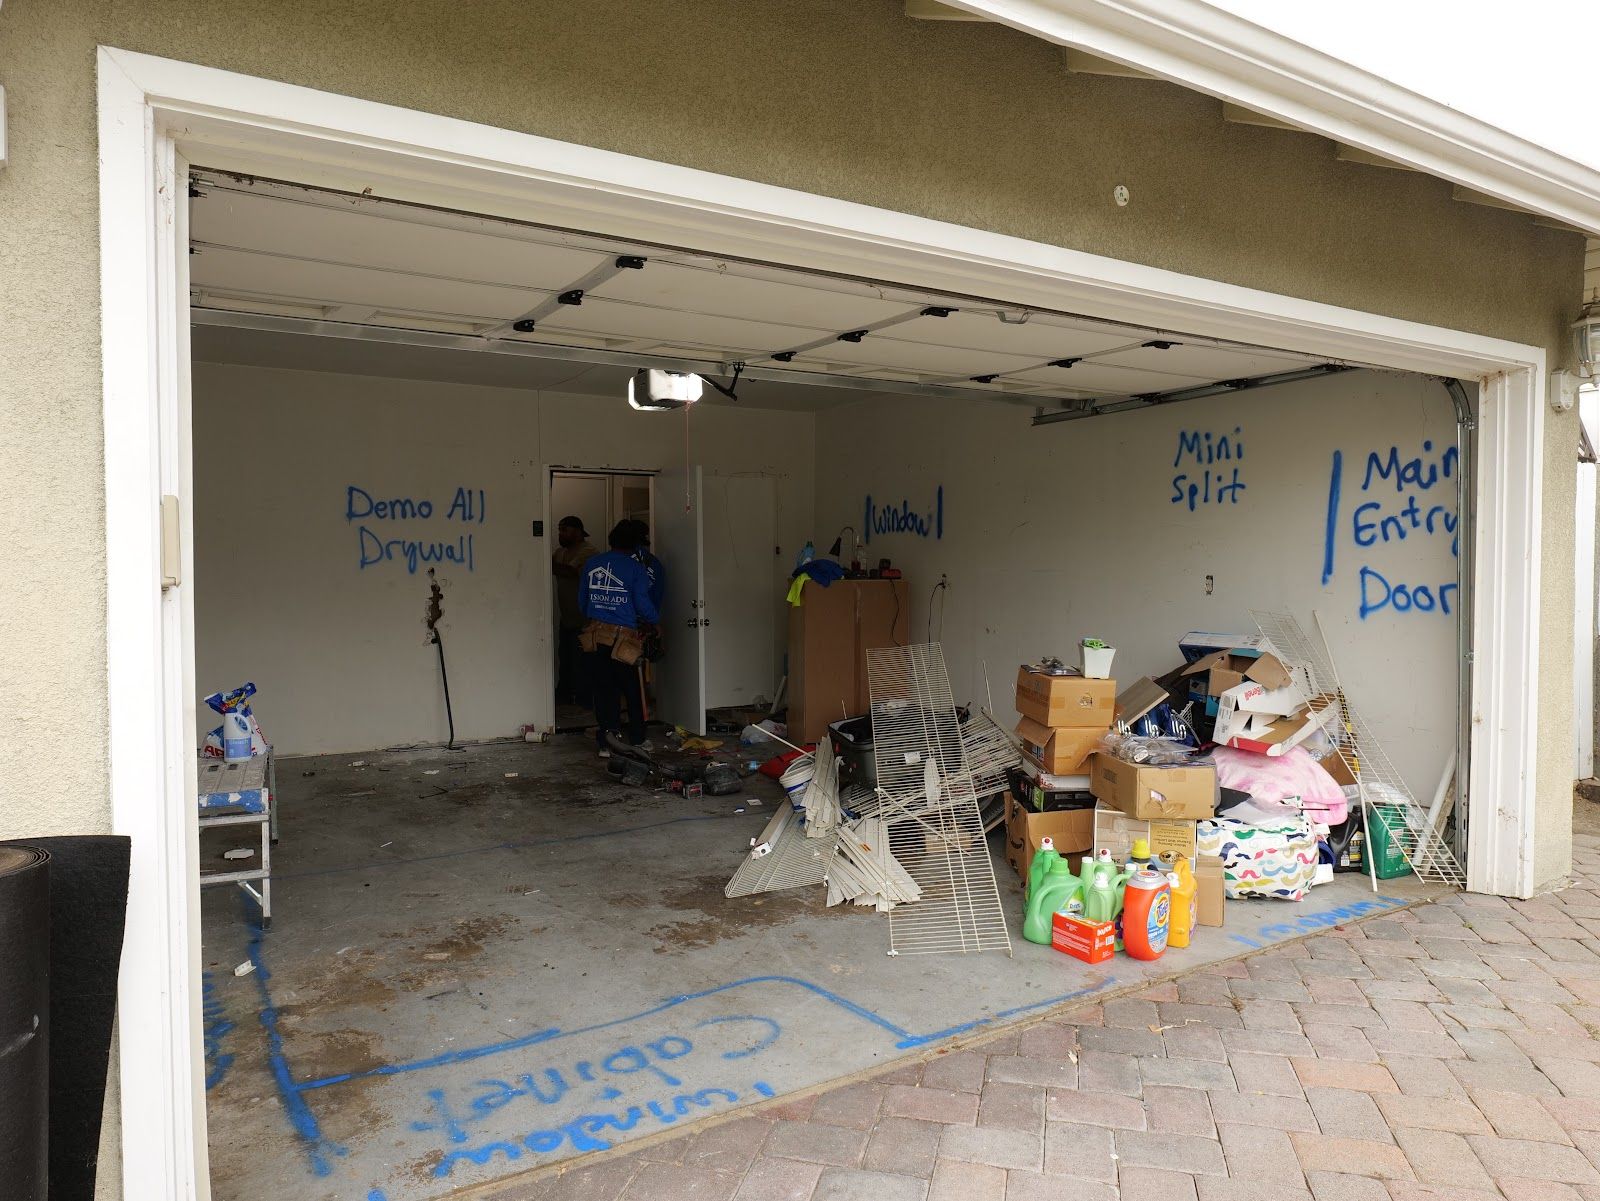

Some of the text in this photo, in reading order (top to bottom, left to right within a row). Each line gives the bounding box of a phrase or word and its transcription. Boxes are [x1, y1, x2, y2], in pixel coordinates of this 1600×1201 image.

[1174, 427, 1243, 468] Mini
[1361, 440, 1458, 492] Main
[346, 486, 485, 523] Demo All
[1171, 468, 1247, 512] Split
[360, 526, 473, 574] Drywall
[1359, 566, 1457, 620] Door
[411, 1015, 780, 1142] Cabinet
